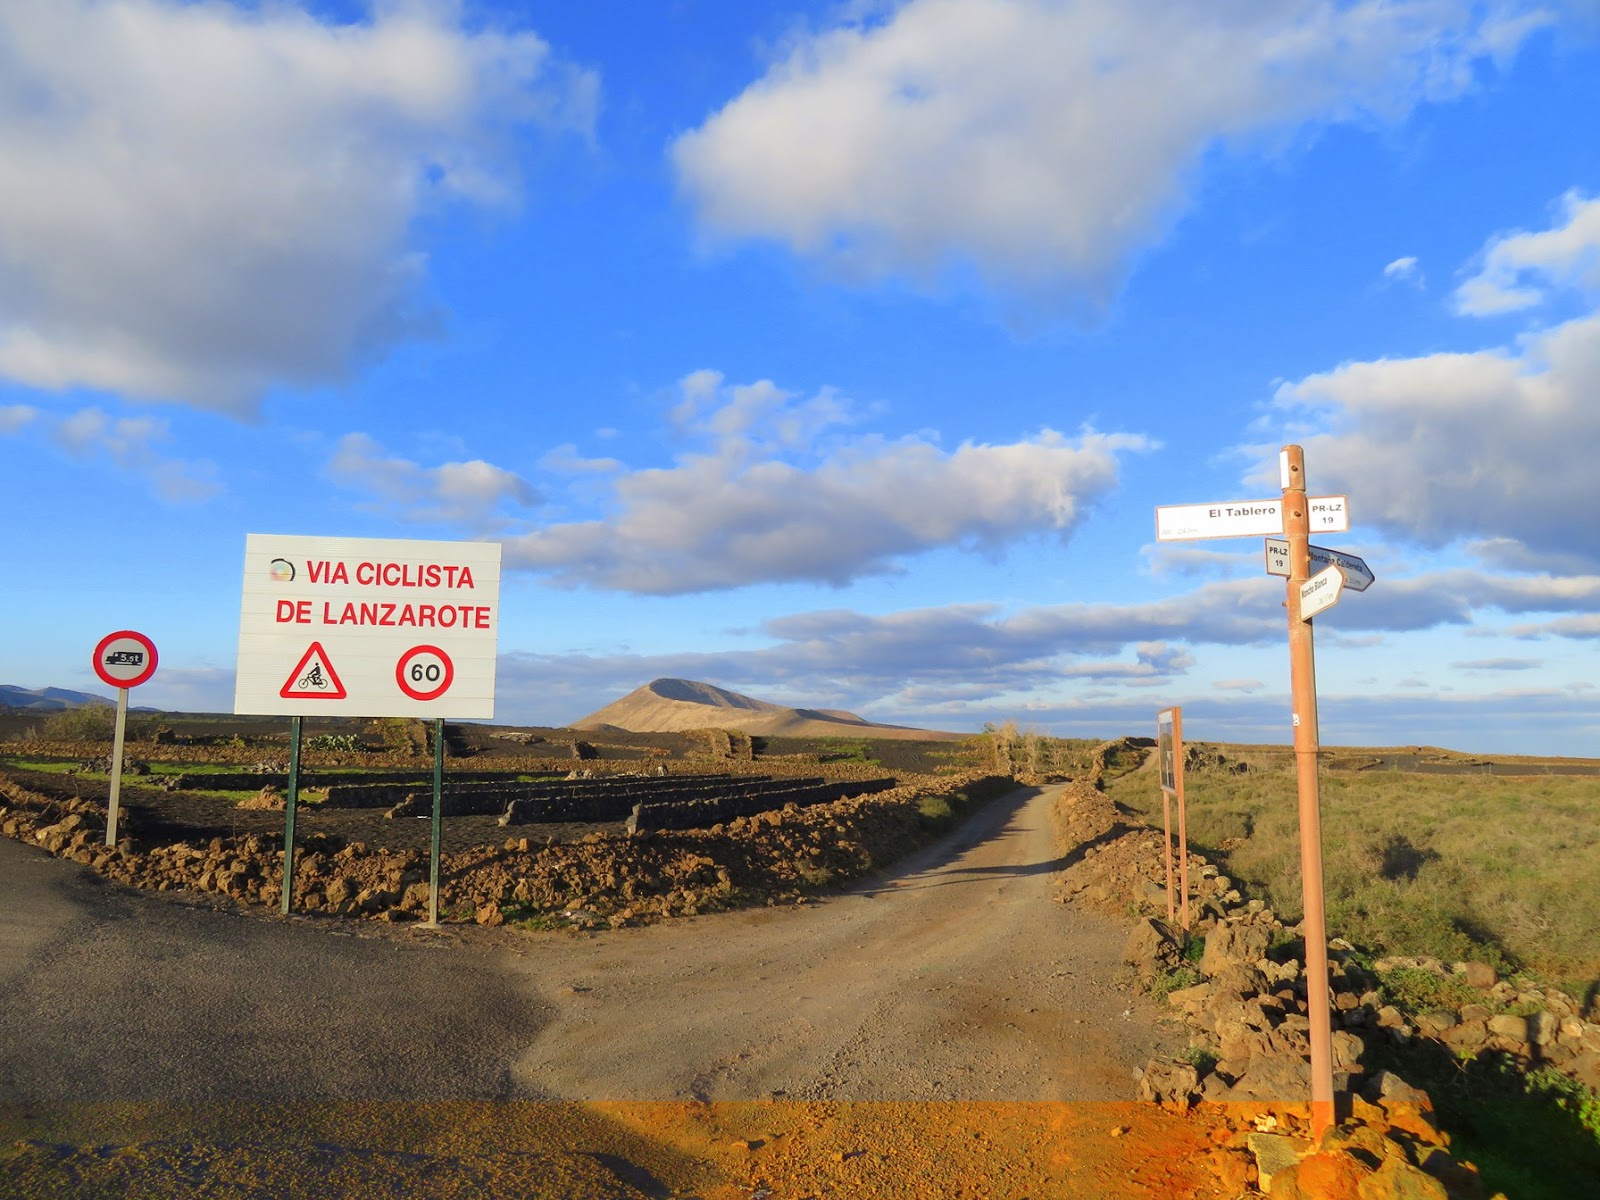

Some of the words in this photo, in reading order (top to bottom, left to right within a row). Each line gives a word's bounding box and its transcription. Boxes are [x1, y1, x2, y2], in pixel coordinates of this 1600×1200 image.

[1209, 509, 1221, 518] El
[1225, 507, 1276, 517] Tablero
[1312, 504, 1342, 512] PR-LZ
[1322, 516, 1334, 524] 19
[1269, 546, 1288, 556] PR-LZ
[1275, 559, 1284, 567] 19
[306, 560, 349, 585] VIA
[356, 562, 475, 589] CICLISTA
[275, 600, 312, 624] DE
[323, 601, 491, 629] LANZAROTE
[411, 663, 441, 682] 60
